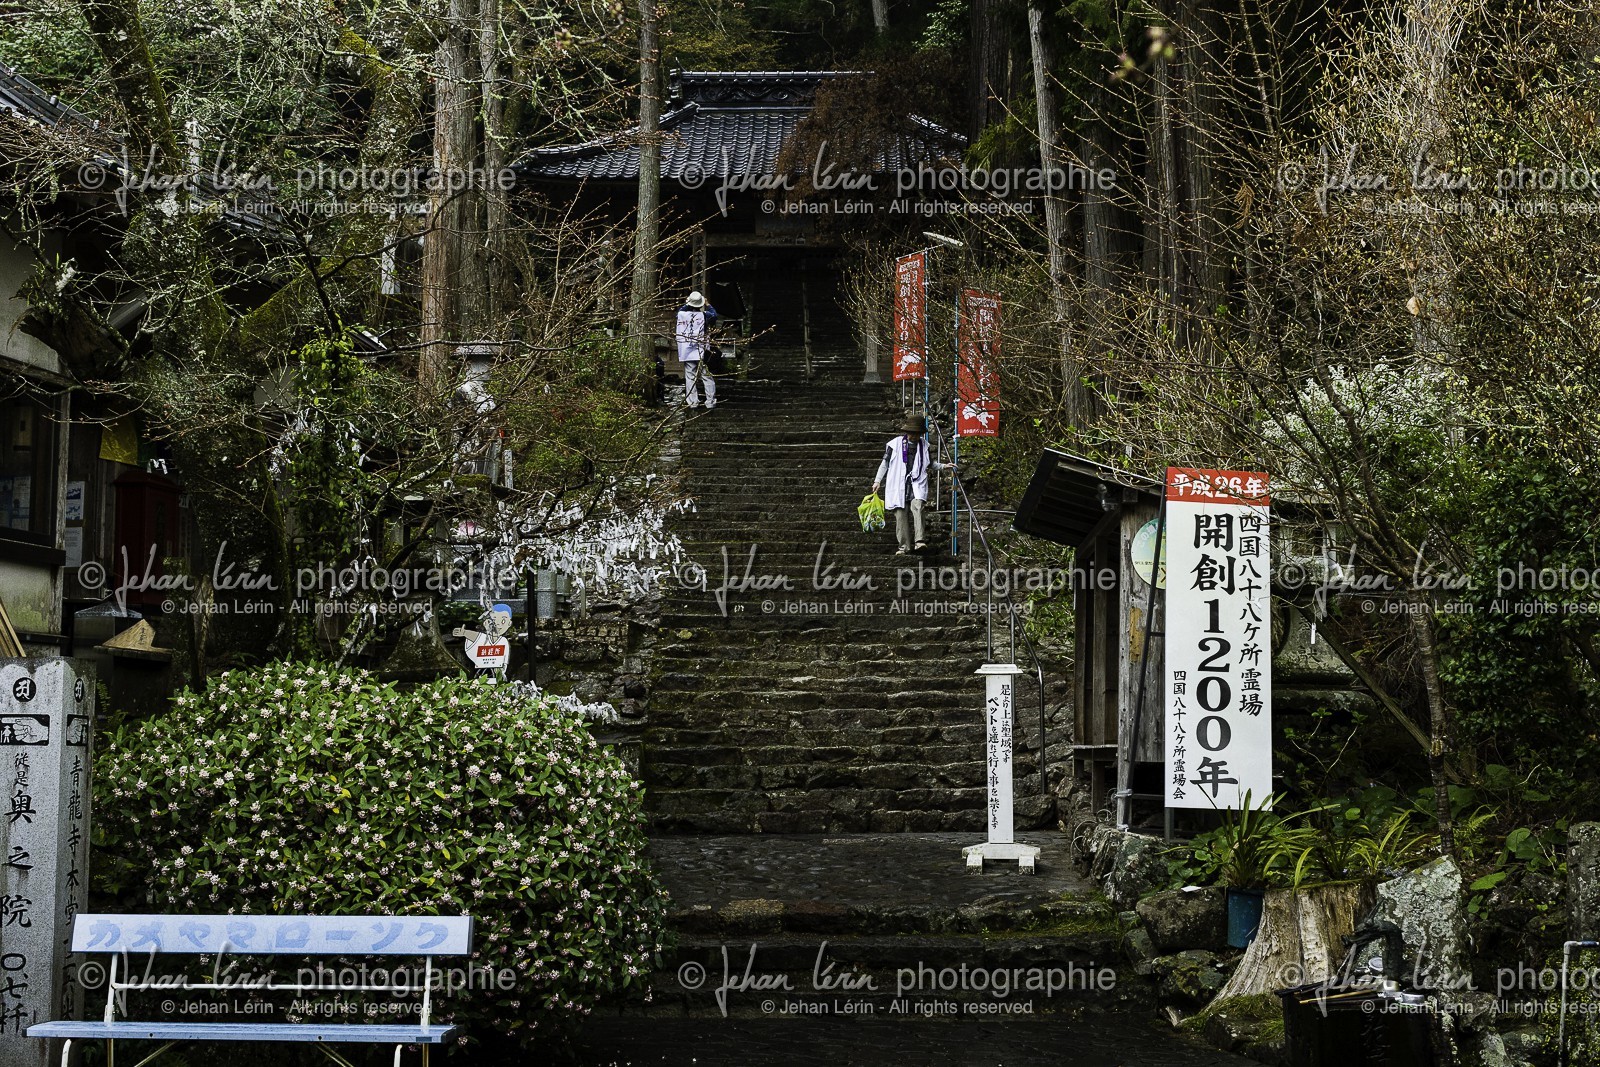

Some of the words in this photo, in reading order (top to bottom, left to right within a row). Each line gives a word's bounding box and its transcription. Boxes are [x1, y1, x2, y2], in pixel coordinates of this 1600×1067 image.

[1171, 473, 1266, 498] 平成26年
[1190, 513, 1239, 799] 開創1200年
[988, 696, 999, 830] ペットを連れて行く事を禁じます
[1000, 684, 1012, 764] 是より上は聖域です
[86, 919, 450, 950] カメヤマローソク
